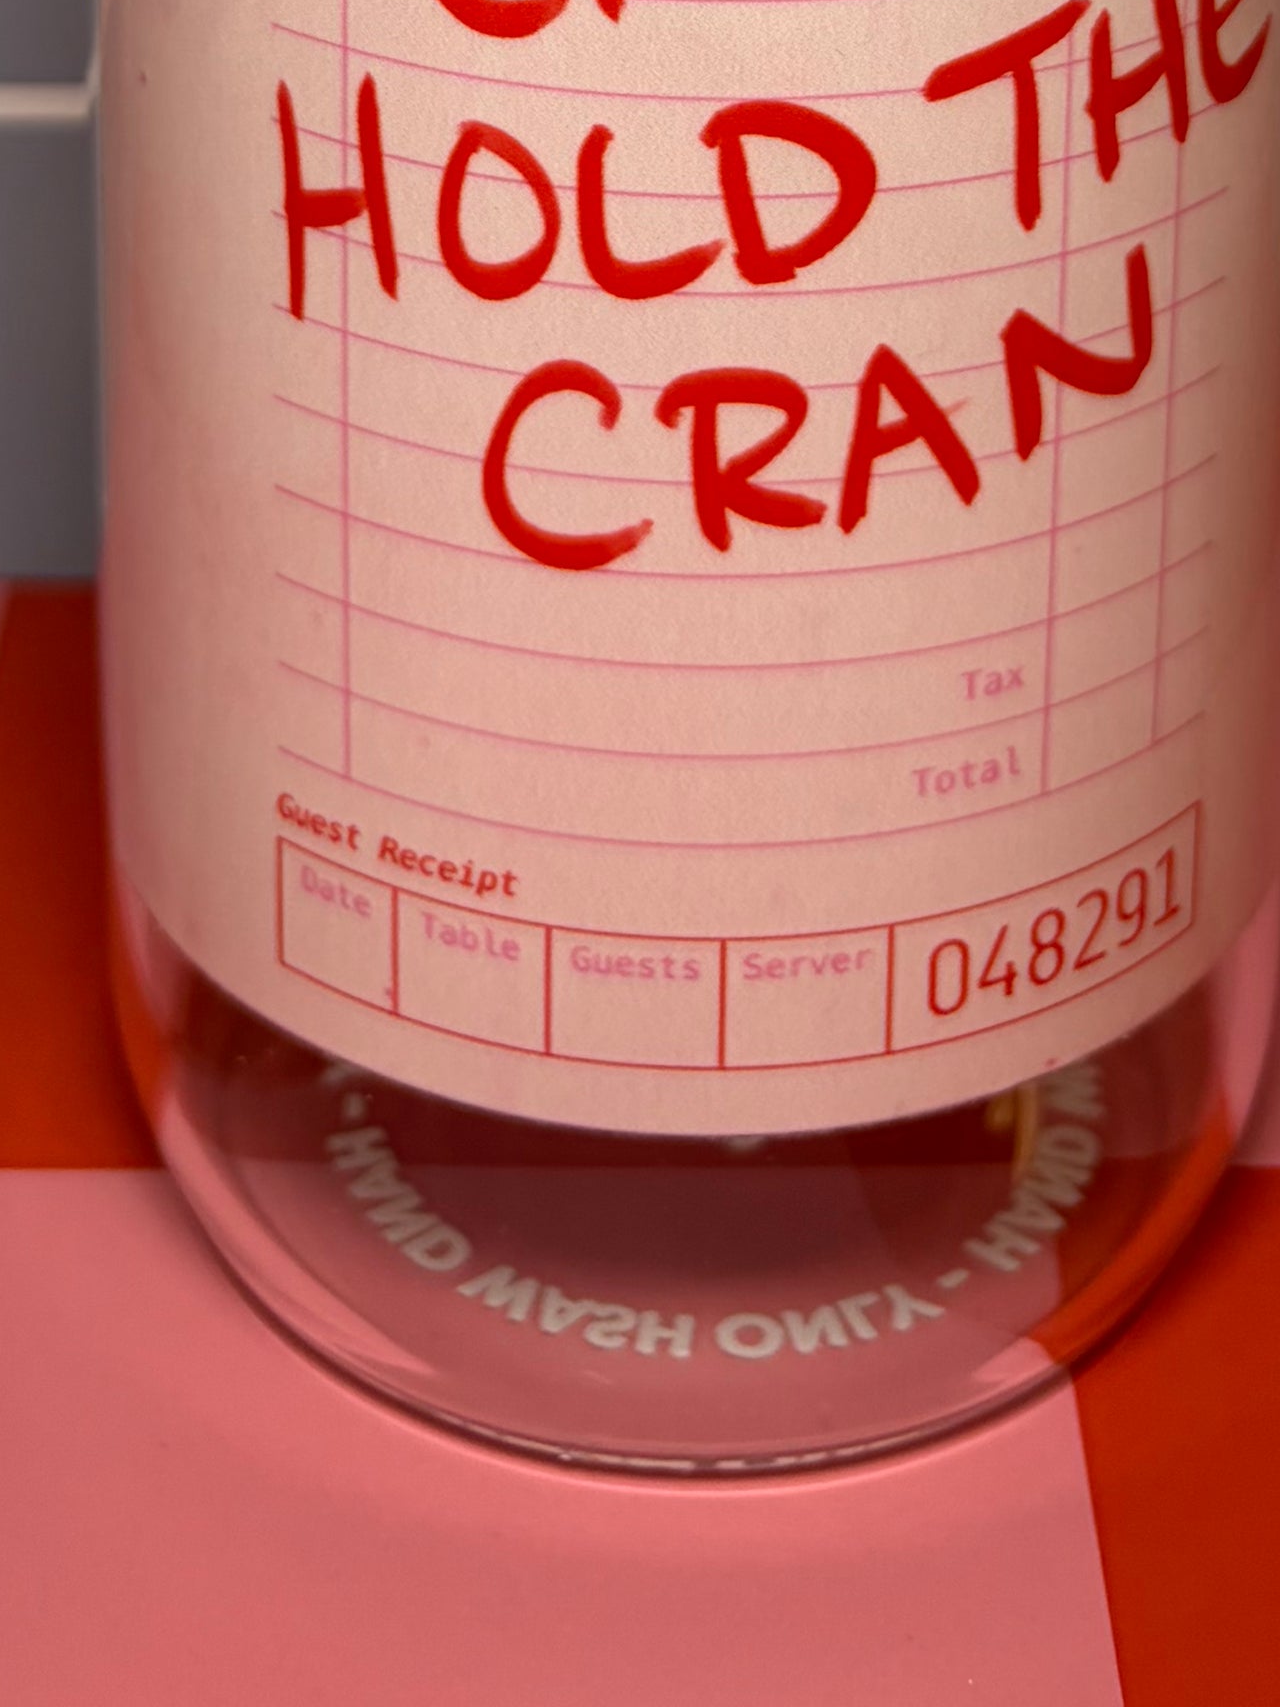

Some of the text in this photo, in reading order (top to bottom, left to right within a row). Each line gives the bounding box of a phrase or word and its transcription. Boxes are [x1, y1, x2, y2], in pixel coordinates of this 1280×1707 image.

[276, 72, 877, 321] HOLD
[482, 242, 1153, 571] CRAN
[962, 664, 1025, 701] Tax
[913, 745, 1021, 798] Total
[276, 792, 519, 898] Guest Receipt
[300, 846, 1180, 1017] Date Table Guests Server 048291
